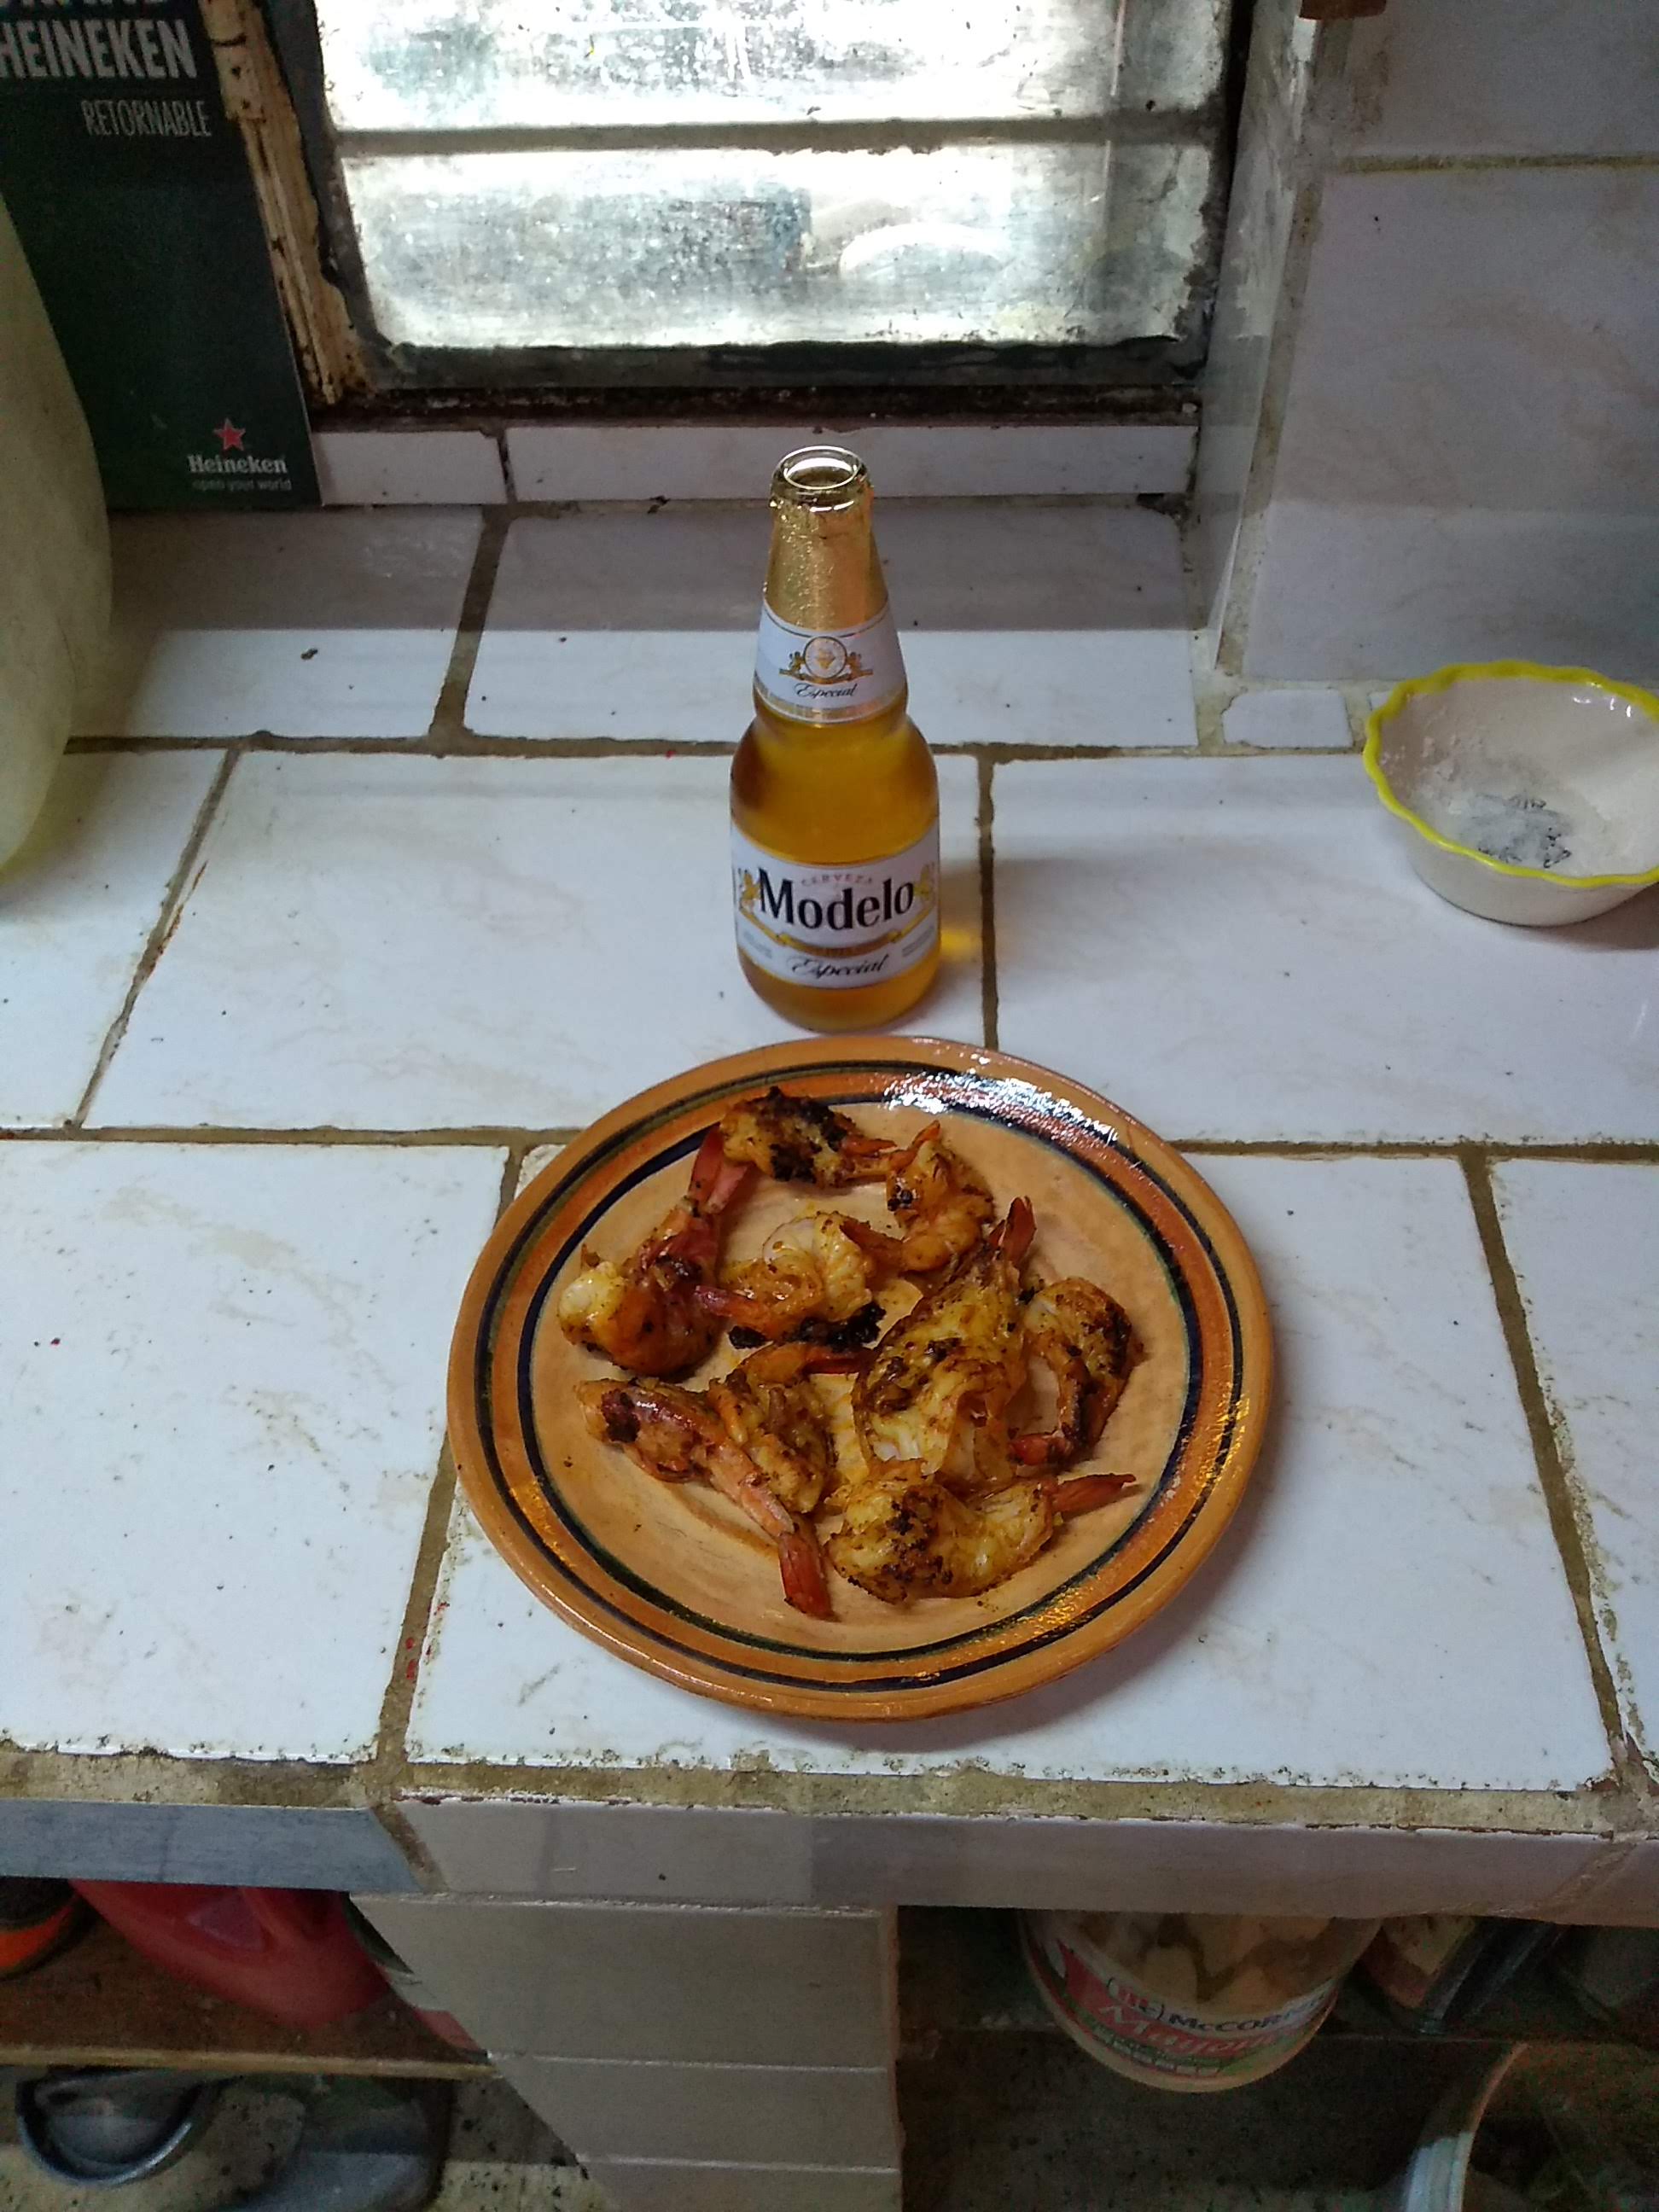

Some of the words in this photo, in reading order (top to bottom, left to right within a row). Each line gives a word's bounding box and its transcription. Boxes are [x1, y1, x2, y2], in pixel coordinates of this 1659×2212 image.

[0, 19, 198, 79] HEINEKEN
[81, 99, 212, 137] RETORNABLE
[186, 453, 288, 474] Heineken
[793, 683, 858, 699] Especial
[757, 866, 915, 931] Modelo
[785, 953, 889, 980] Especial
